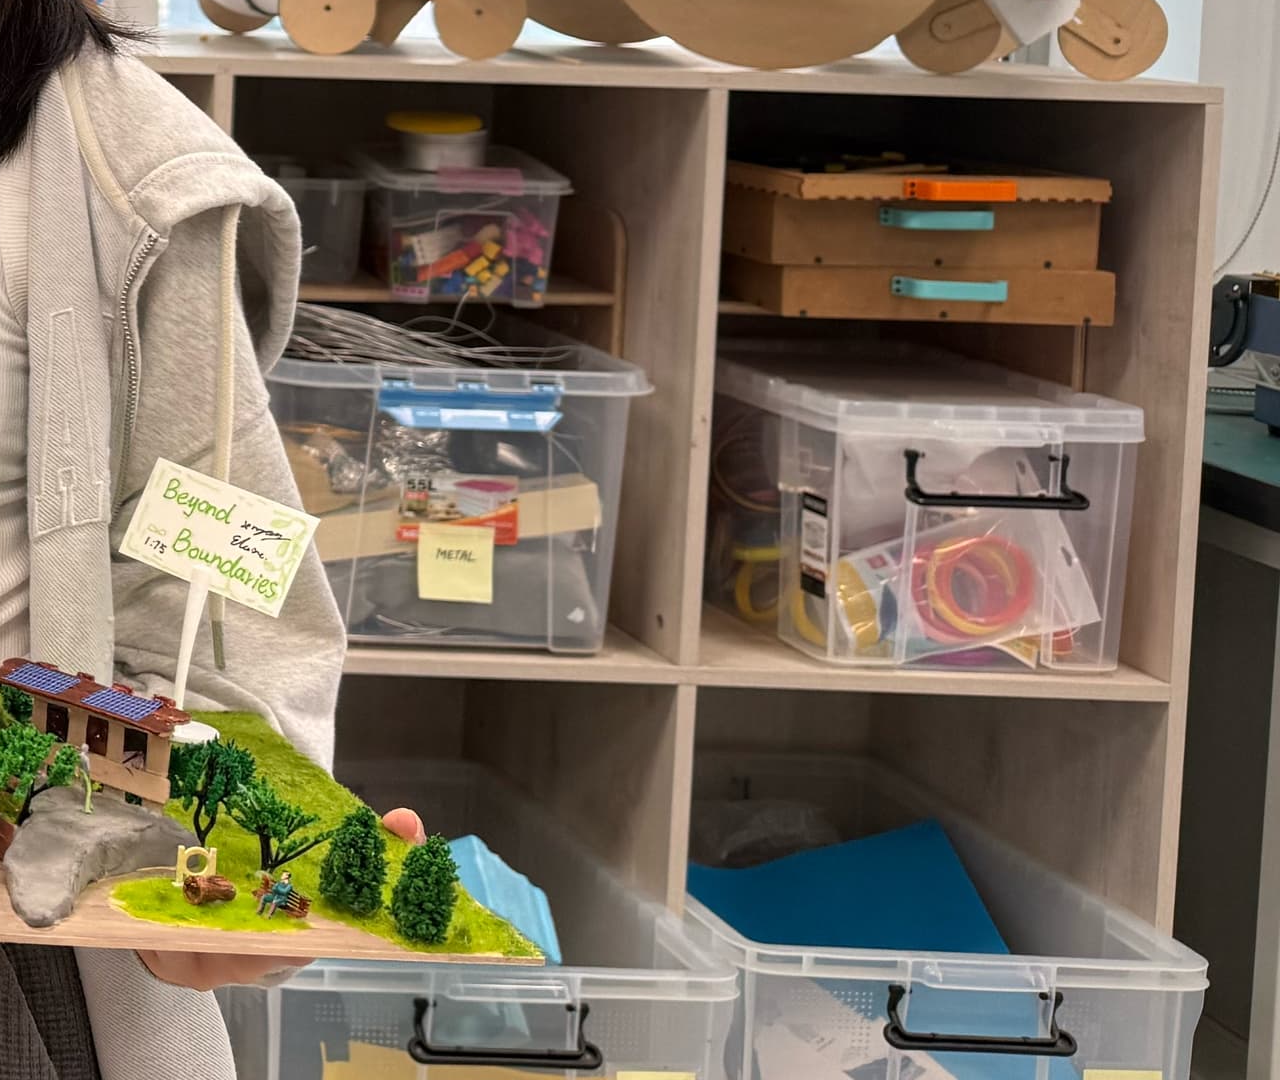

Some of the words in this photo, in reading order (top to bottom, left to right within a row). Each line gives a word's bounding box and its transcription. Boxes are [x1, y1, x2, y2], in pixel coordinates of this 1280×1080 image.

[162, 478, 237, 524] Beyond
[172, 528, 278, 600] Boundaries
[436, 548, 476, 562] METAL
